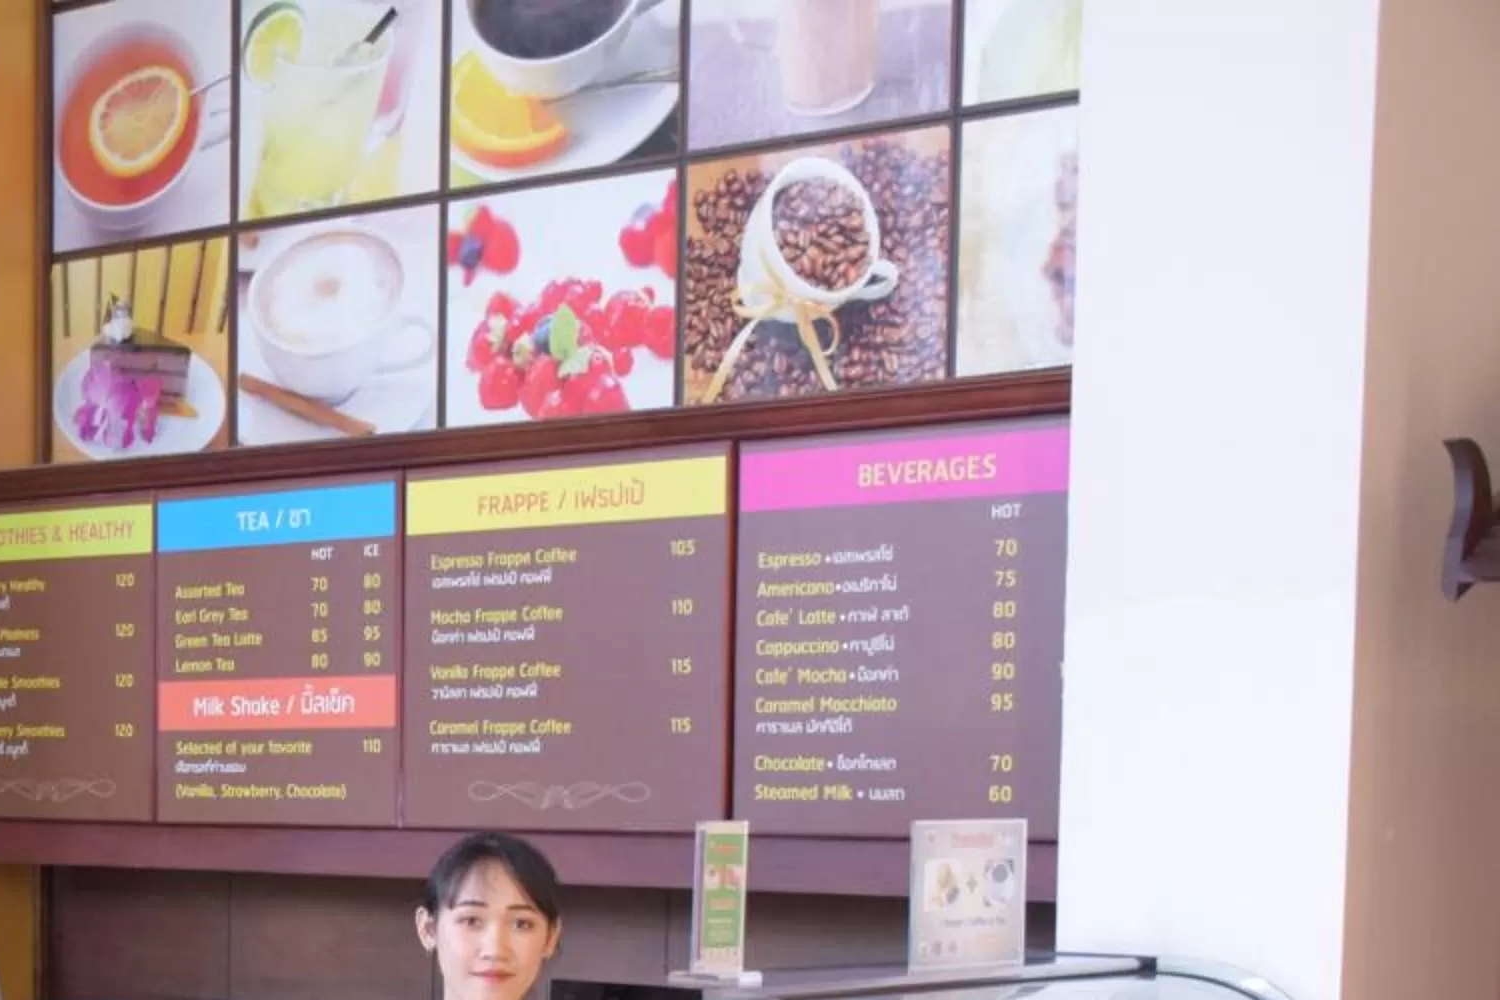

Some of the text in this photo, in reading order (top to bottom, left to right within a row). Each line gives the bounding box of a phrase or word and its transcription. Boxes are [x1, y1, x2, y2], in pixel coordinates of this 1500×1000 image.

[857, 453, 998, 488] BEVERAGES
[477, 492, 549, 517] FRAPPE
[991, 503, 1021, 520] HOT
[68, 519, 134, 542] HEALTHY
[236, 511, 270, 531] TEA
[311, 547, 333, 560] HOT
[430, 539, 696, 572] Espresso Frappe Coffee 105
[756, 551, 821, 571] Espresso
[994, 538, 1018, 557] 70
[224, 583, 245, 597] Tea
[311, 576, 328, 592] 70
[756, 580, 835, 598] Americano
[994, 569, 1016, 588] 75
[228, 608, 249, 621] Tea
[311, 602, 328, 619] 70
[430, 599, 693, 626] Mocha Frappe Coffee 110
[798, 607, 837, 626] Latte
[992, 600, 1016, 619] 80
[211, 634, 231, 647] Tea
[756, 637, 840, 657] Cappuccino
[991, 631, 1015, 650] 80
[216, 658, 235, 672] Tea
[472, 663, 516, 682] Frappe
[519, 661, 561, 678] Coffee
[671, 657, 693, 675] 115
[797, 667, 848, 684] Mocha
[991, 662, 1015, 681] 90
[193, 696, 225, 717] Milk
[231, 695, 280, 717] Shake
[755, 692, 1013, 714] Caramel Macchiato 95
[429, 717, 692, 737] Caramel Frappe Coffee 115
[175, 741, 222, 756] Selected
[225, 741, 237, 755] of
[241, 743, 265, 757] your
[363, 738, 381, 753] 110
[754, 753, 825, 772] Chocolate
[989, 753, 1013, 772] 70
[754, 783, 817, 801] Steamed
[823, 783, 853, 801] Milk
[988, 783, 1013, 803] 60
